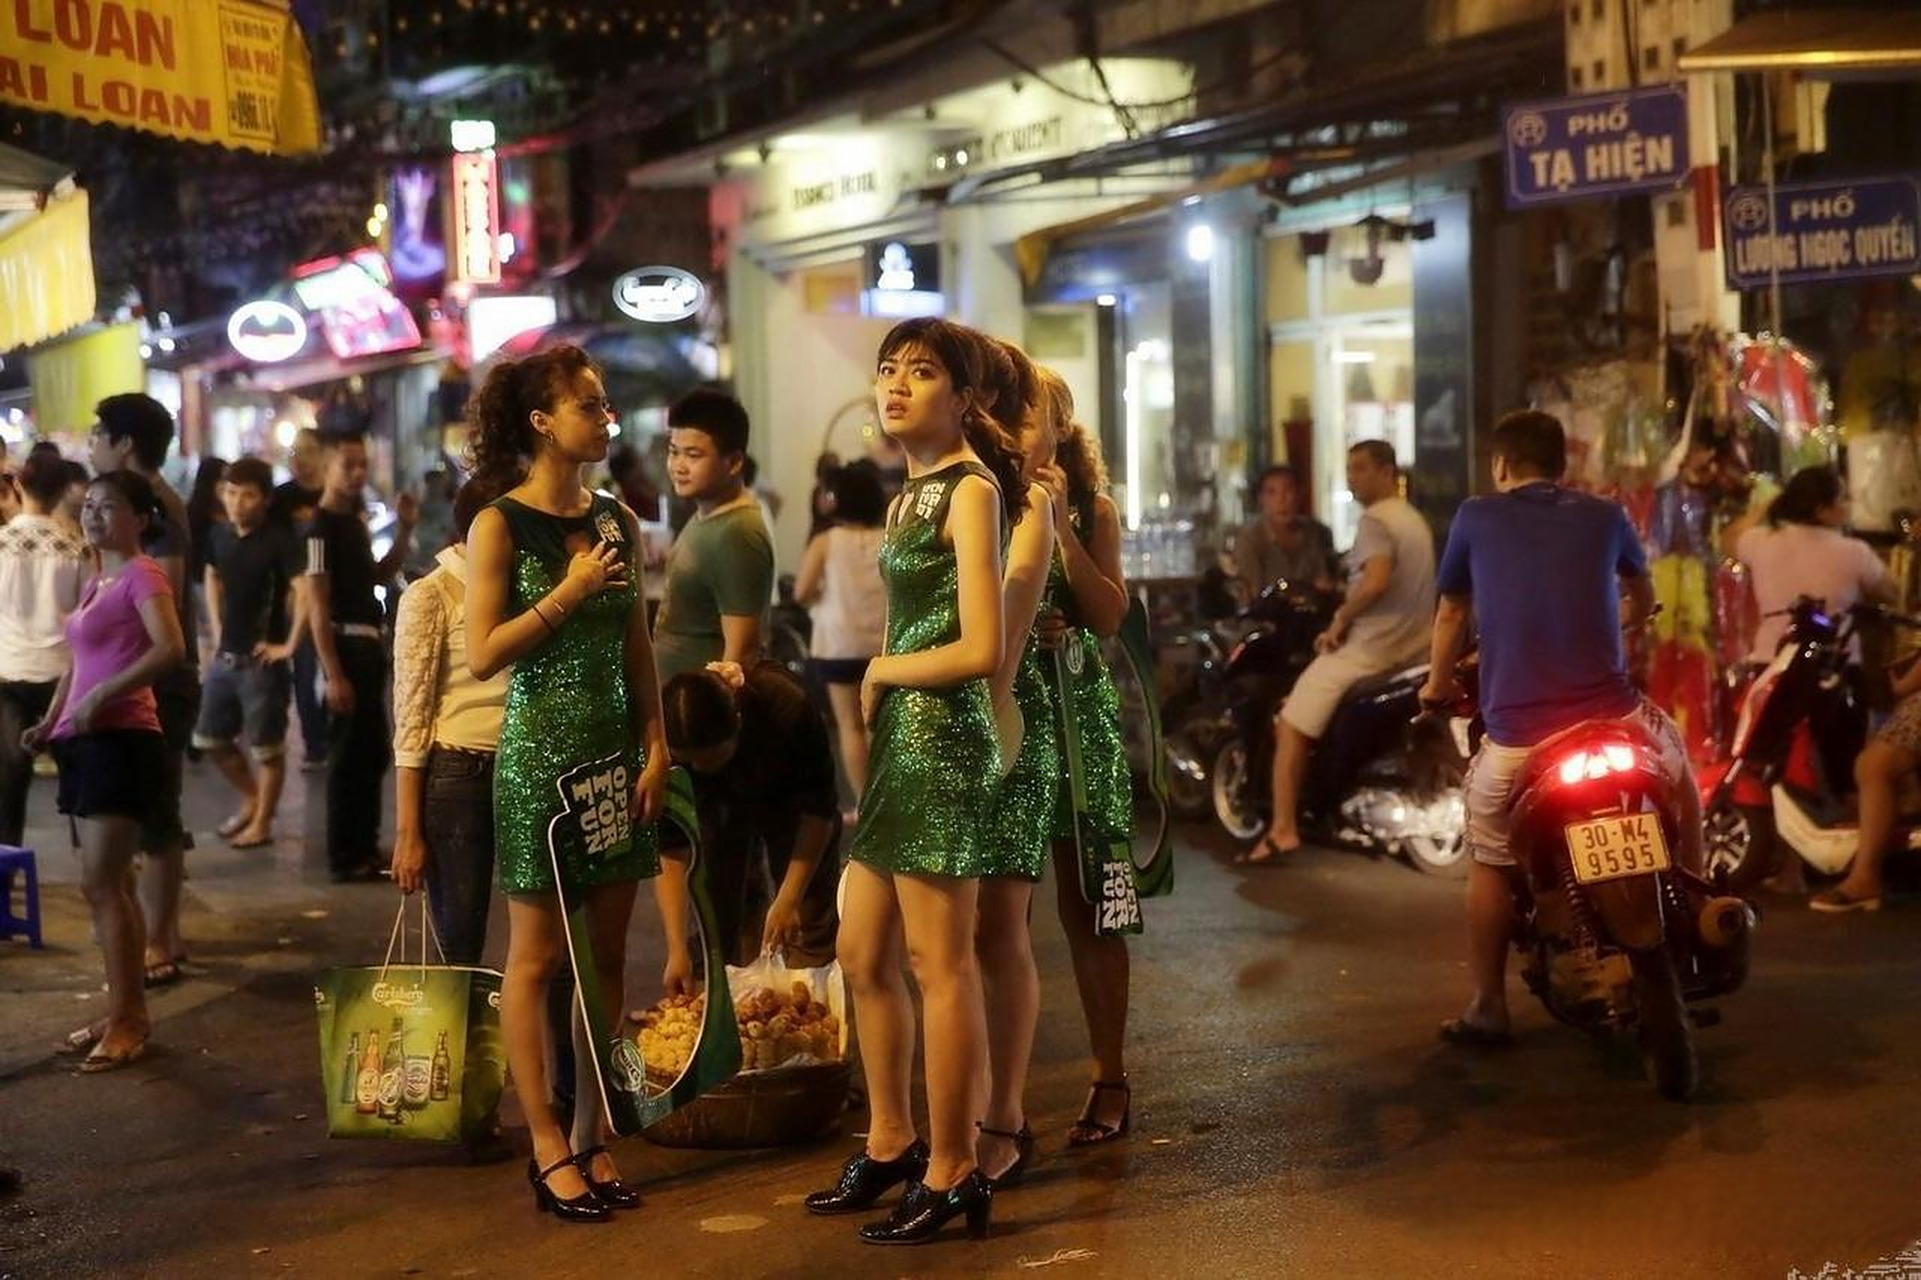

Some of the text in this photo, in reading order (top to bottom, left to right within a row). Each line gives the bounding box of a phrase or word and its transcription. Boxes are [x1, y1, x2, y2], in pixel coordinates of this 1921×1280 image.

[14, 0, 175, 71] LOAN
[72, 71, 211, 132] LOAN
[1568, 103, 1628, 136] PHỐ
[1530, 131, 1673, 192] TẠ HIỆN
[1790, 189, 1855, 222] PHỐ
[571, 778, 604, 855] FUN
[592, 769, 618, 850] FOR
[613, 766, 629, 840] OPEN
[1588, 844, 1655, 876] 9595
[1102, 863, 1116, 929] FUN
[1113, 861, 1129, 928] FOR
